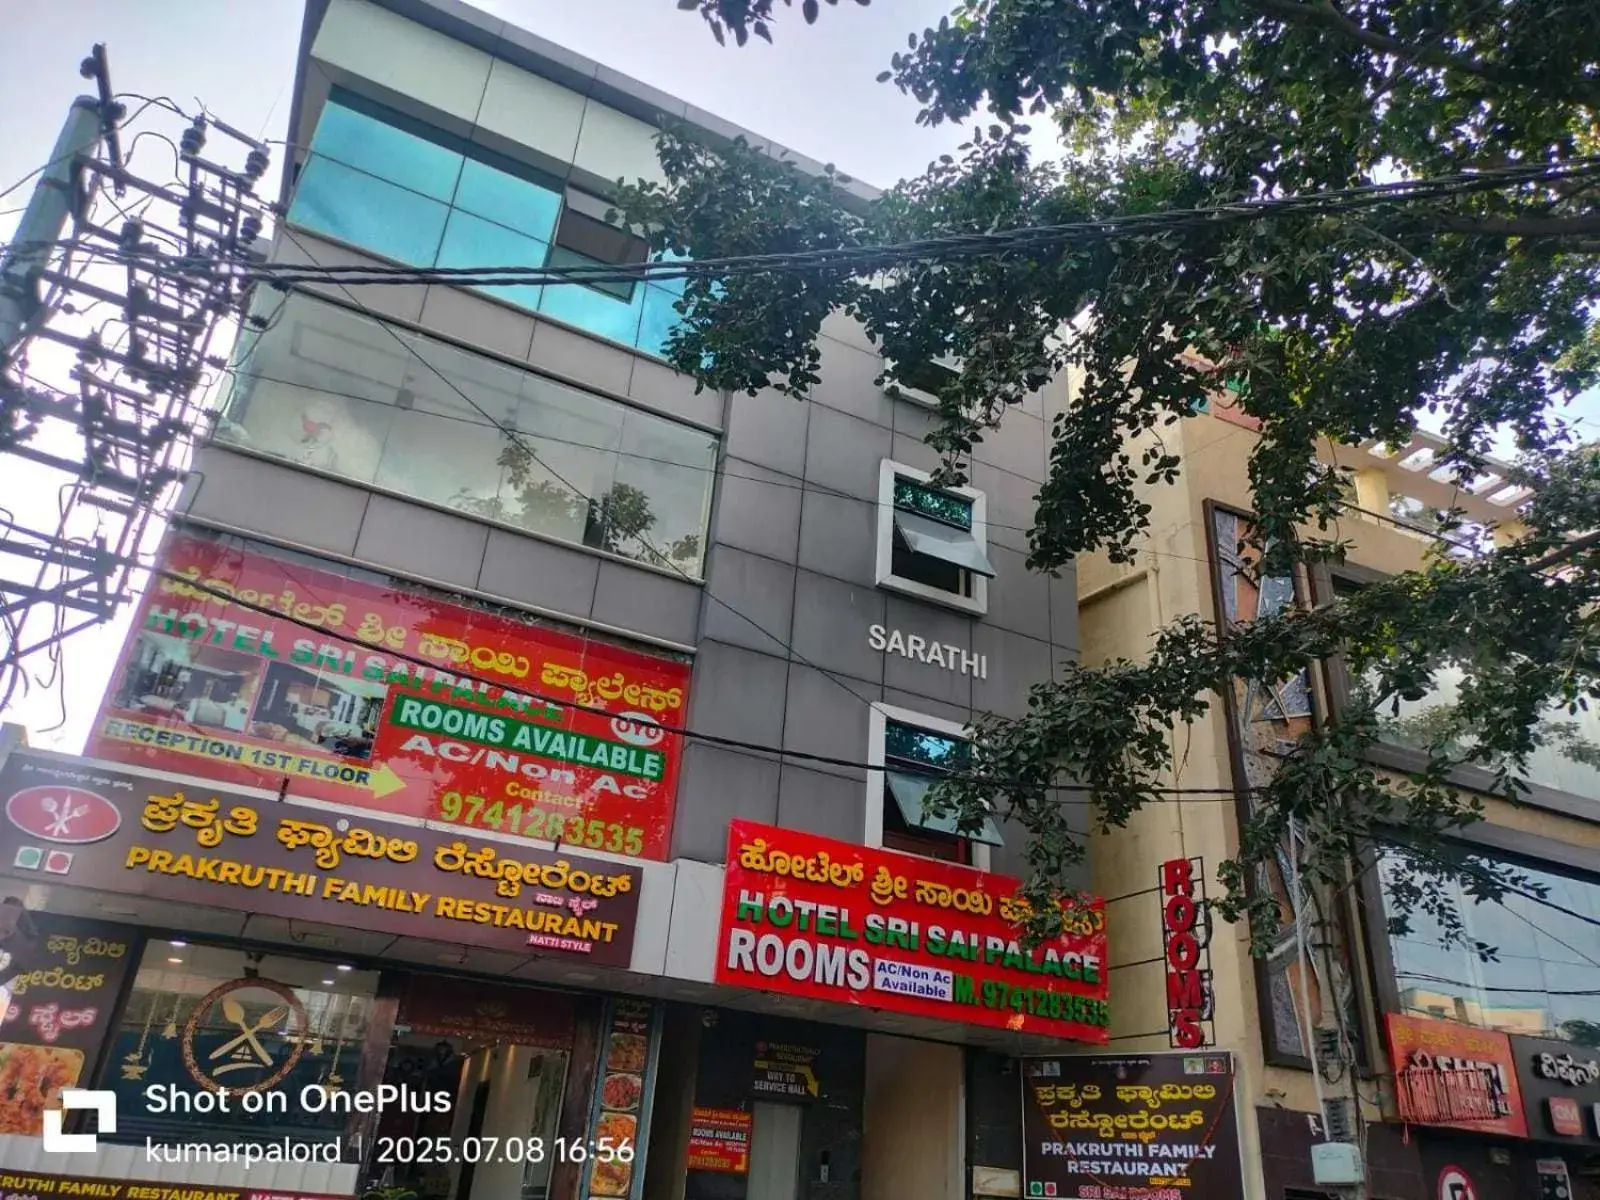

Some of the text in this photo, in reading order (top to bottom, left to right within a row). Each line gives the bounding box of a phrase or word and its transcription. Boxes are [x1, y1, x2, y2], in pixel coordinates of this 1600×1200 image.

[146, 604, 564, 722] HOTEL SRI SAI PALACE
[418, 632, 530, 678] ಸಾಯಿ
[540, 660, 683, 712] ಪ್ಯಾಲೇಸ್
[868, 624, 987, 679] SARATHI
[104, 719, 370, 785] RECEPTION 1ST FLOOR
[399, 699, 661, 778] ROOMS AVAILABLE
[400, 734, 650, 800] AC/Non Ac
[140, 792, 632, 898] ಪ್ರಕೃತಿ ಫ್ಯಾಮಿಲಿ ರೆಸ್ಟೋರೆಂಟ್
[441, 791, 644, 856] 9741283535
[125, 846, 618, 943] PRAKRUTHI FAMILY RESTAURANT
[740, 837, 864, 888] ಹೋಟೆಲ್
[870, 865, 908, 905] ಶ್ರೀ
[915, 879, 993, 916] ಸಾಯಿ
[530, 934, 592, 953] NATTI STYLE
[727, 927, 869, 990] ROOMS
[736, 888, 1101, 984] HOTEL SRI SAI PALACE
[1163, 858, 1204, 1048] ROOMS
[877, 961, 950, 986] AC/Non Ac
[882, 977, 946, 998] Available
[1116, 1082, 1216, 1109] ಫ್ಯಾಮಿಲಿ
[1041, 1142, 1216, 1159] PRAKRUTHI FAMILY
[1067, 1161, 1188, 1177] RESTAURANT
[0, 1174, 55, 1192] RUTHI
[58, 1180, 122, 1197] FAMILY
[127, 1186, 240, 1200] RESTAURANT
